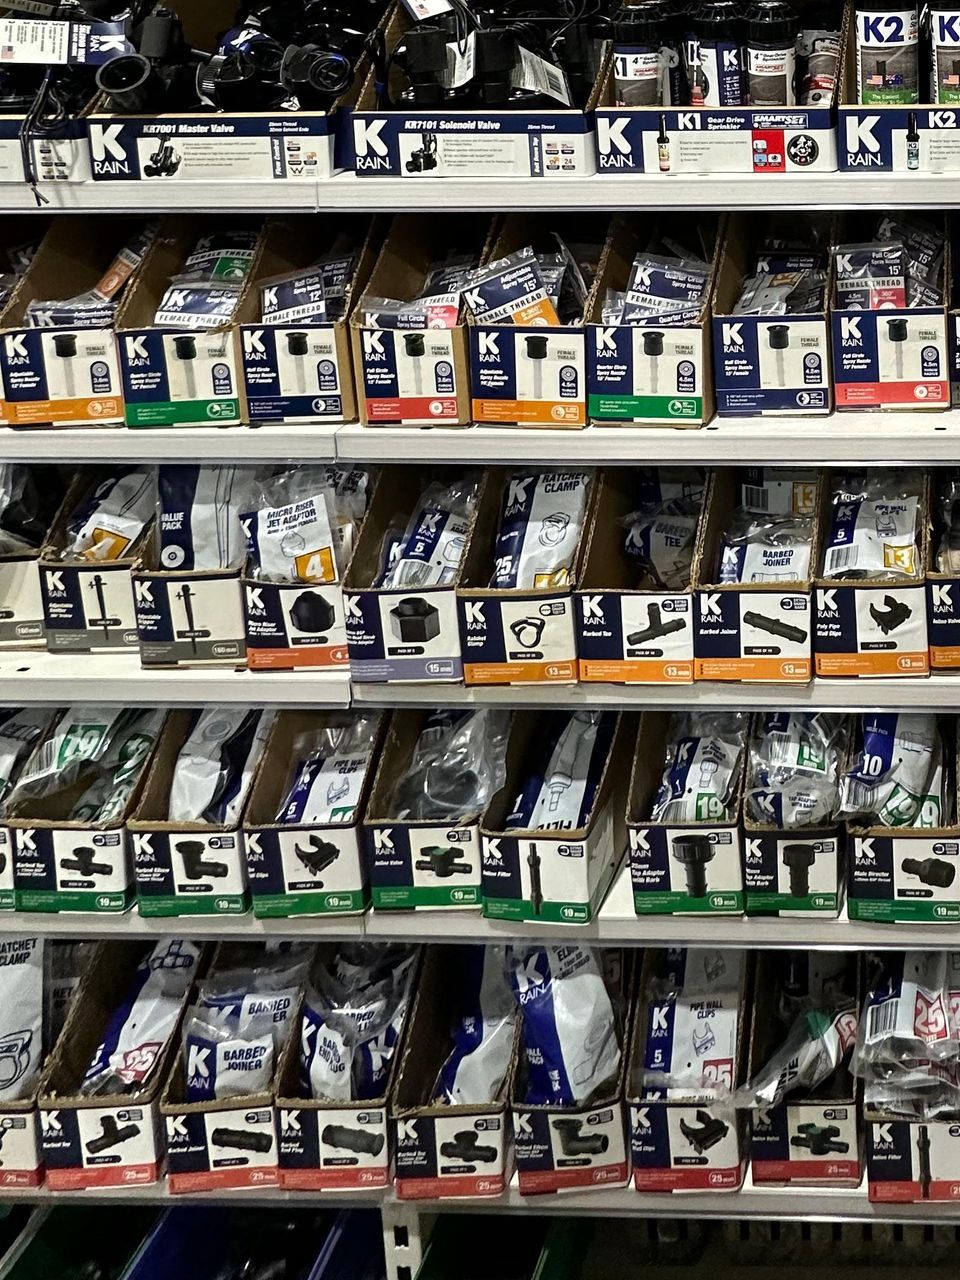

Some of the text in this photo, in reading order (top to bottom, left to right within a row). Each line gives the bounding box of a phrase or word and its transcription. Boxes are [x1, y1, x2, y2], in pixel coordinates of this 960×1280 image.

[864, 16, 904, 43] K2
[404, 121, 500, 130] KR7101 Solenoid Valve
[678, 113, 701, 130] K1
[754, 115, 806, 124] SMARTSET
[929, 111, 956, 128] K2
[143, 124, 235, 133] KR7001 Master Valve
[846, 116, 881, 153] K
[90, 124, 127, 161] K
[354, 119, 388, 156] K
[598, 118, 632, 154] K
[357, 156, 390, 169] RAIN
[600, 155, 633, 167] RAIN
[848, 154, 881, 166] RAIN
[94, 161, 129, 174] RAIN
[888, 266, 901, 275] 15'
[523, 279, 537, 292] 15'
[841, 279, 902, 289] FEMALE THREAD
[630, 295, 661, 306] FEMALE
[158, 315, 193, 324] FEMALE
[264, 304, 321, 323] FEMALE THREAD
[542, 473, 586, 484] RATCHET
[544, 481, 580, 493] CLAMP
[267, 500, 314, 519] MICRO RISER
[266, 508, 317, 528] JET ADAPTOR
[162, 520, 183, 530] PACK
[763, 549, 794, 558] BARBED
[306, 555, 324, 578] 4
[763, 556, 791, 566] JOINER
[863, 754, 882, 775] 10
[700, 797, 722, 819] 19
[630, 829, 650, 850] K
[631, 849, 651, 857] RAIN
[690, 1001, 723, 1011] PIPE WALL
[697, 1008, 716, 1019] CLIPS
[914, 996, 947, 1036] 25
[223, 1046, 266, 1062] BARBED
[654, 1049, 662, 1062] 5
[225, 1058, 262, 1071] JOINER
